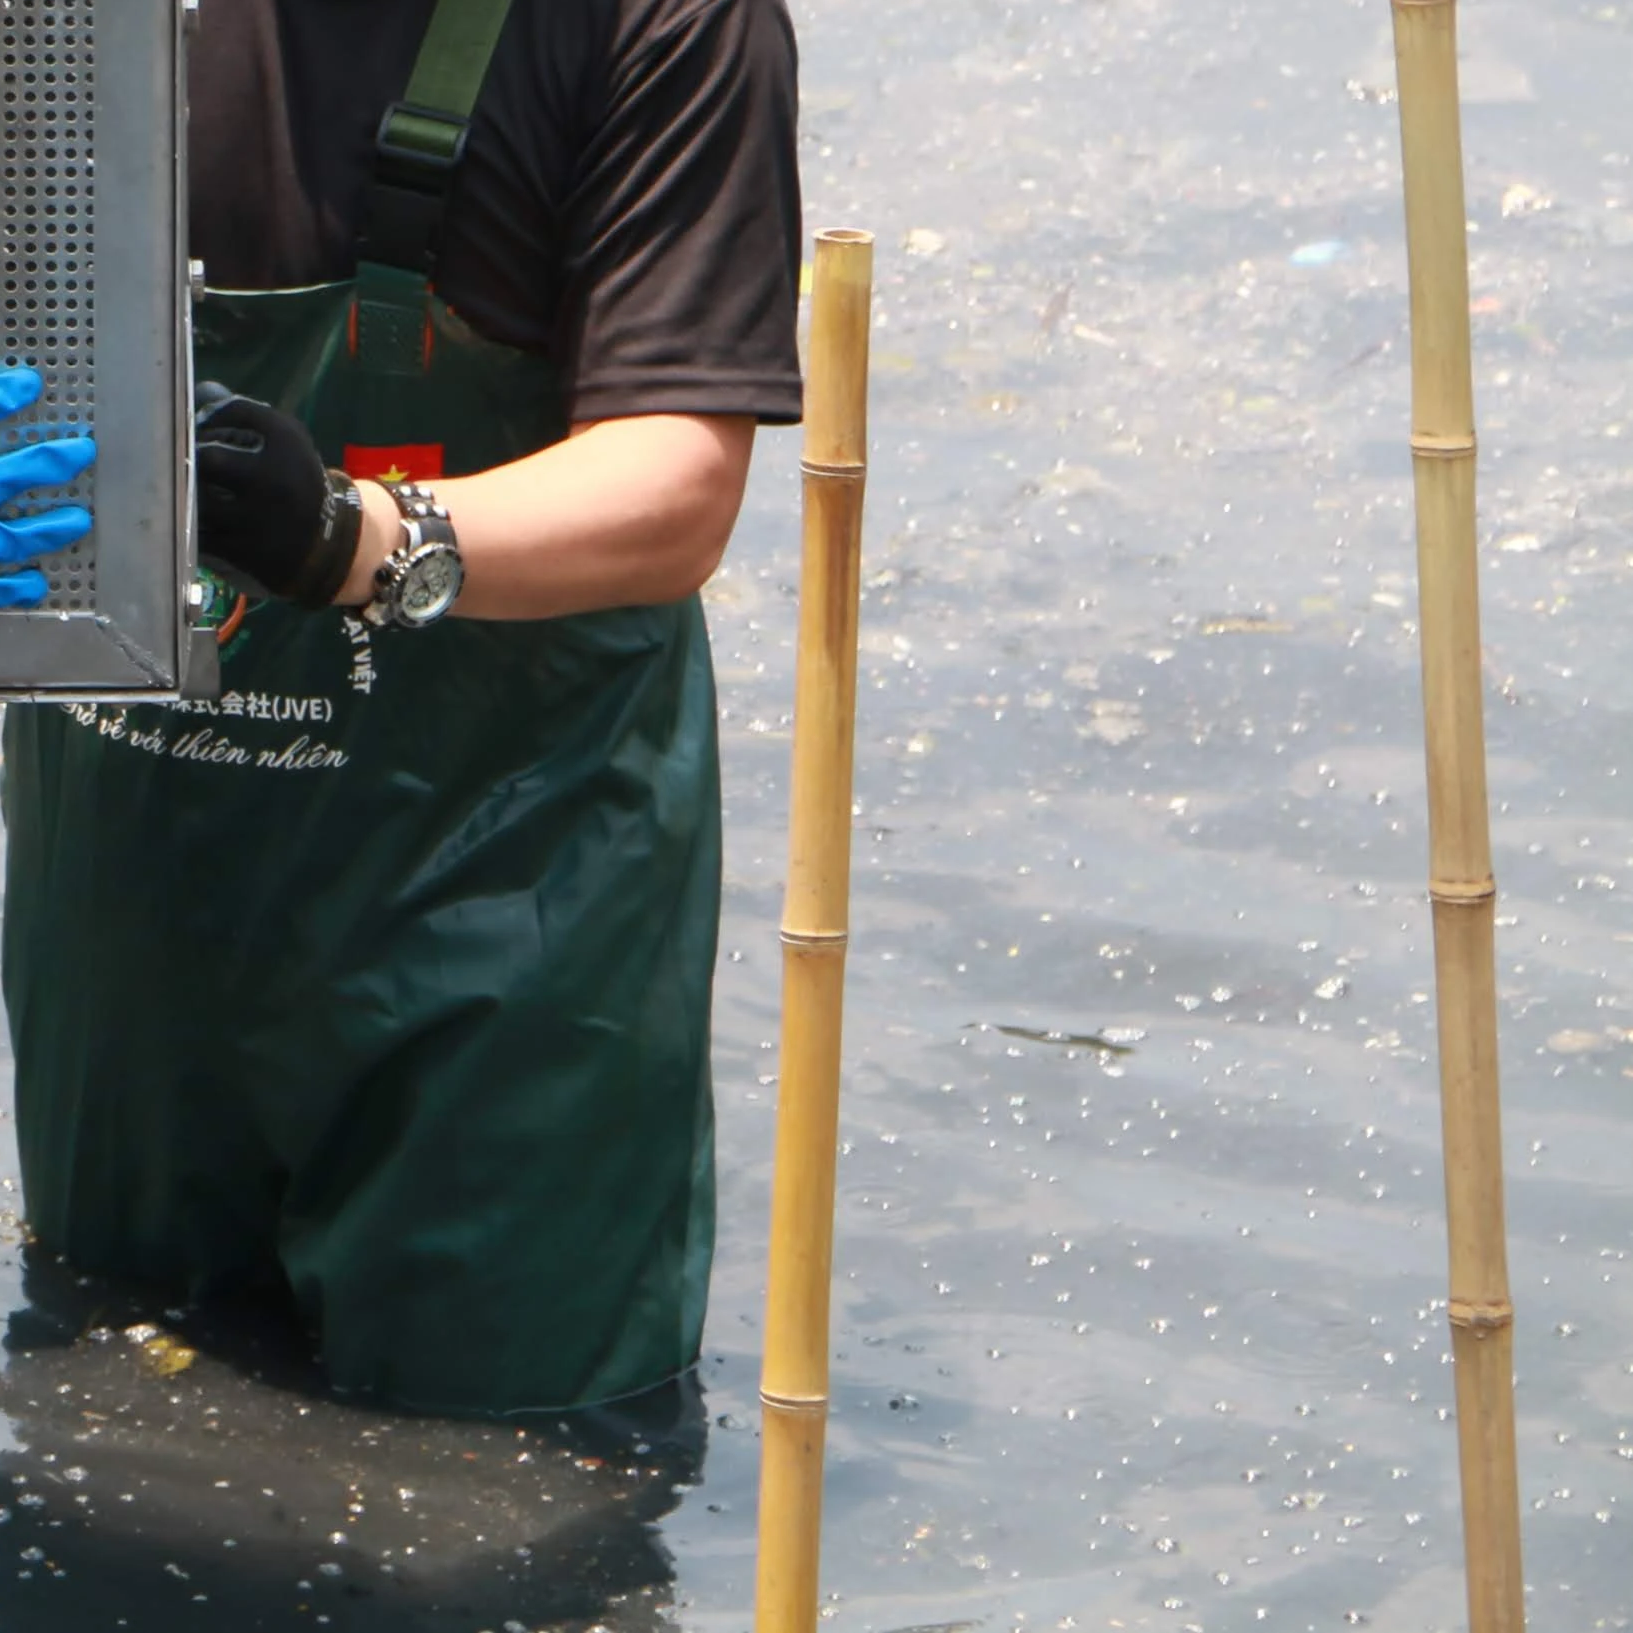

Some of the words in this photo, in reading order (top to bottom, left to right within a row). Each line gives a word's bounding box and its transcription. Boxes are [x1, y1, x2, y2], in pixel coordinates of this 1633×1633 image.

[347, 648, 378, 695] VIỆT
[99, 708, 127, 741] về
[130, 728, 168, 755] với
[171, 728, 253, 765] thiên
[255, 735, 350, 771] nhiên
